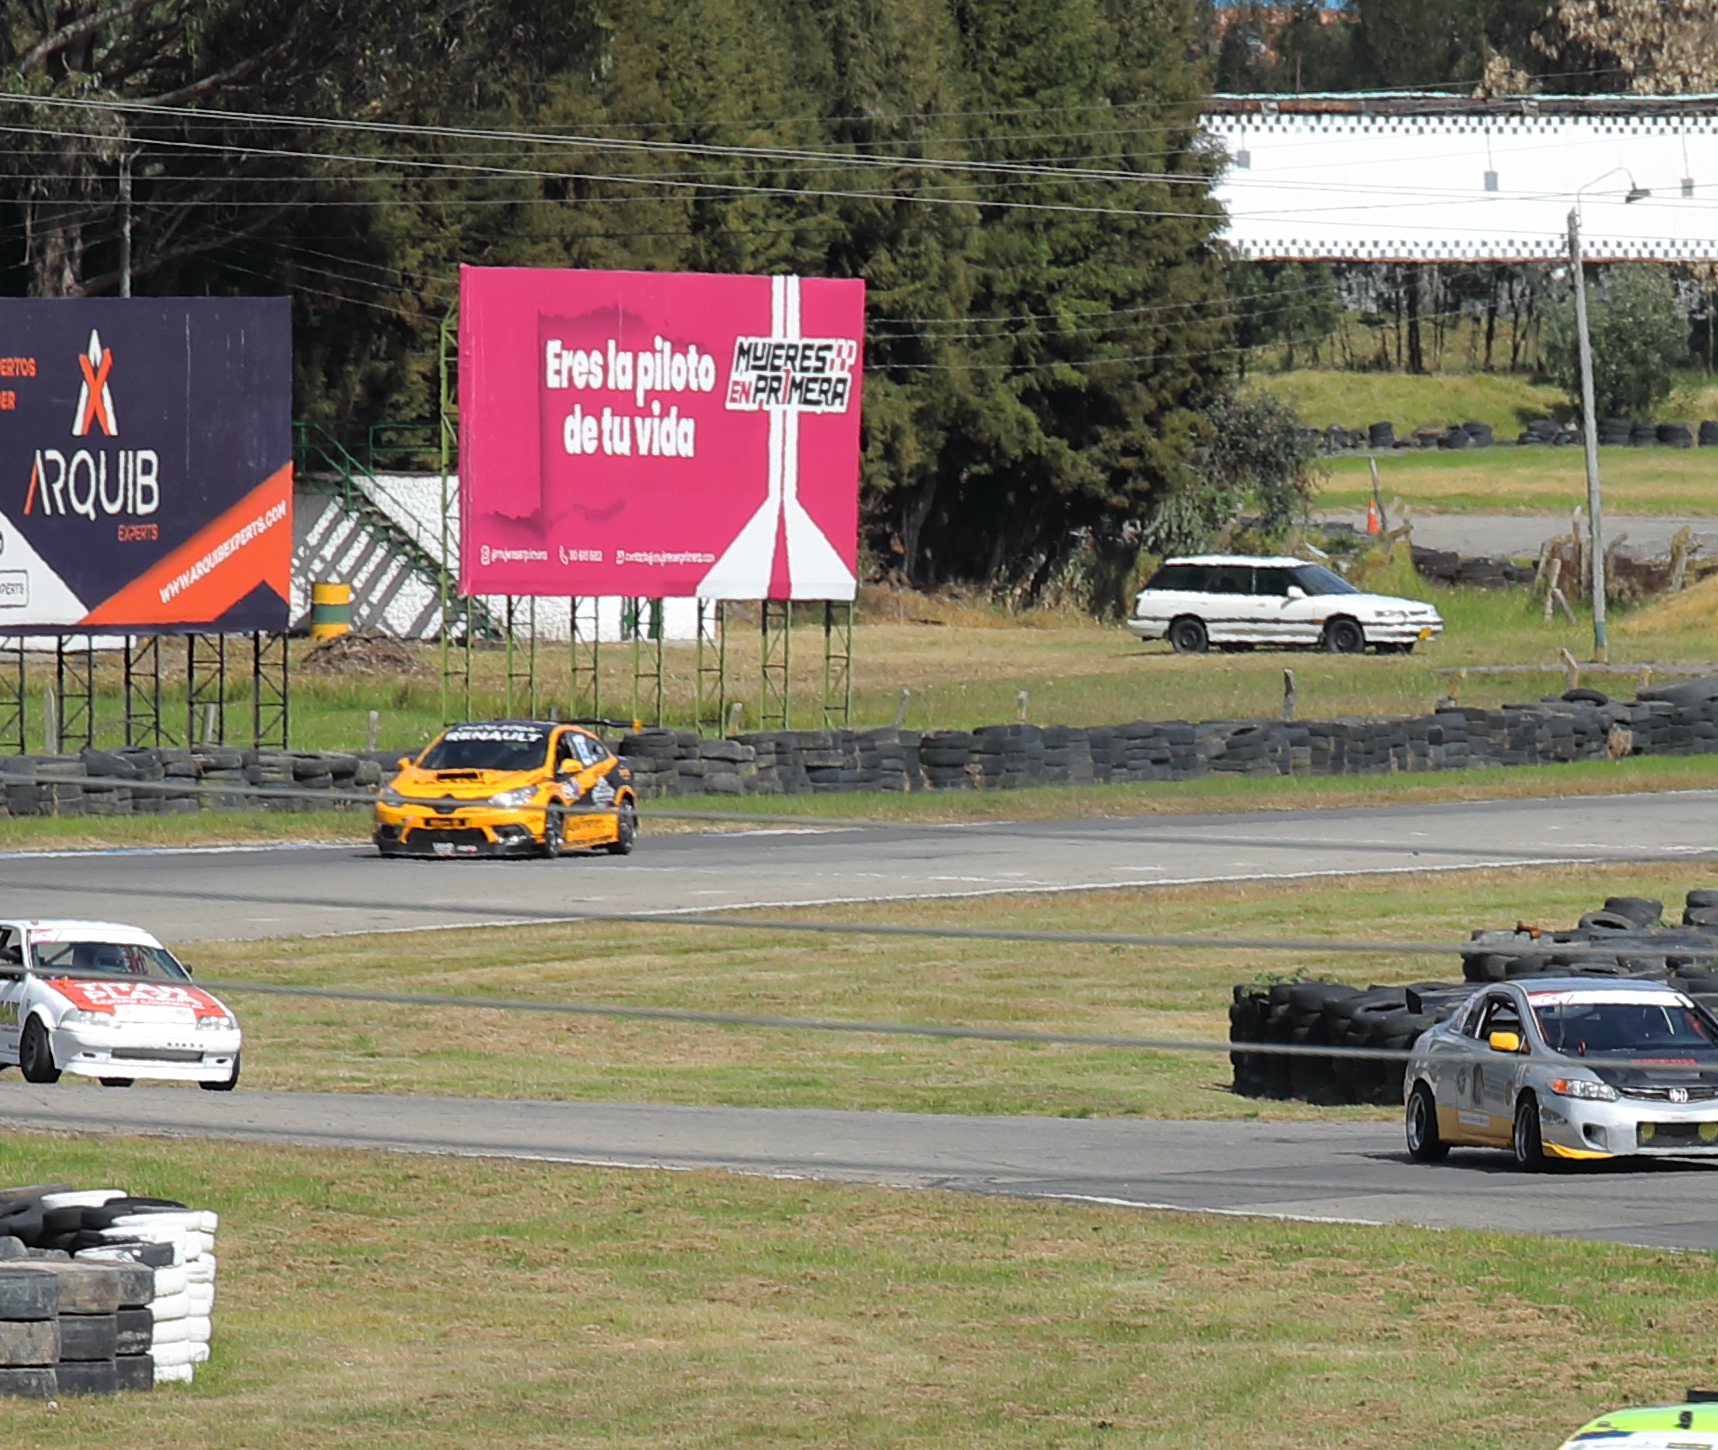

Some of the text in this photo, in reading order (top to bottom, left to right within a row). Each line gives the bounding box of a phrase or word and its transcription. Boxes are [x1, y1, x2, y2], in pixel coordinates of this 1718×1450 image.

[546, 334, 717, 408] Eres la piloto
[735, 341, 834, 373] MUJERES
[729, 380, 752, 404] EN
[563, 399, 697, 458] de tu vida
[24, 448, 160, 522] ARQUIB
[117, 523, 159, 542] EXPERTS
[444, 729, 545, 742] RENAULT
